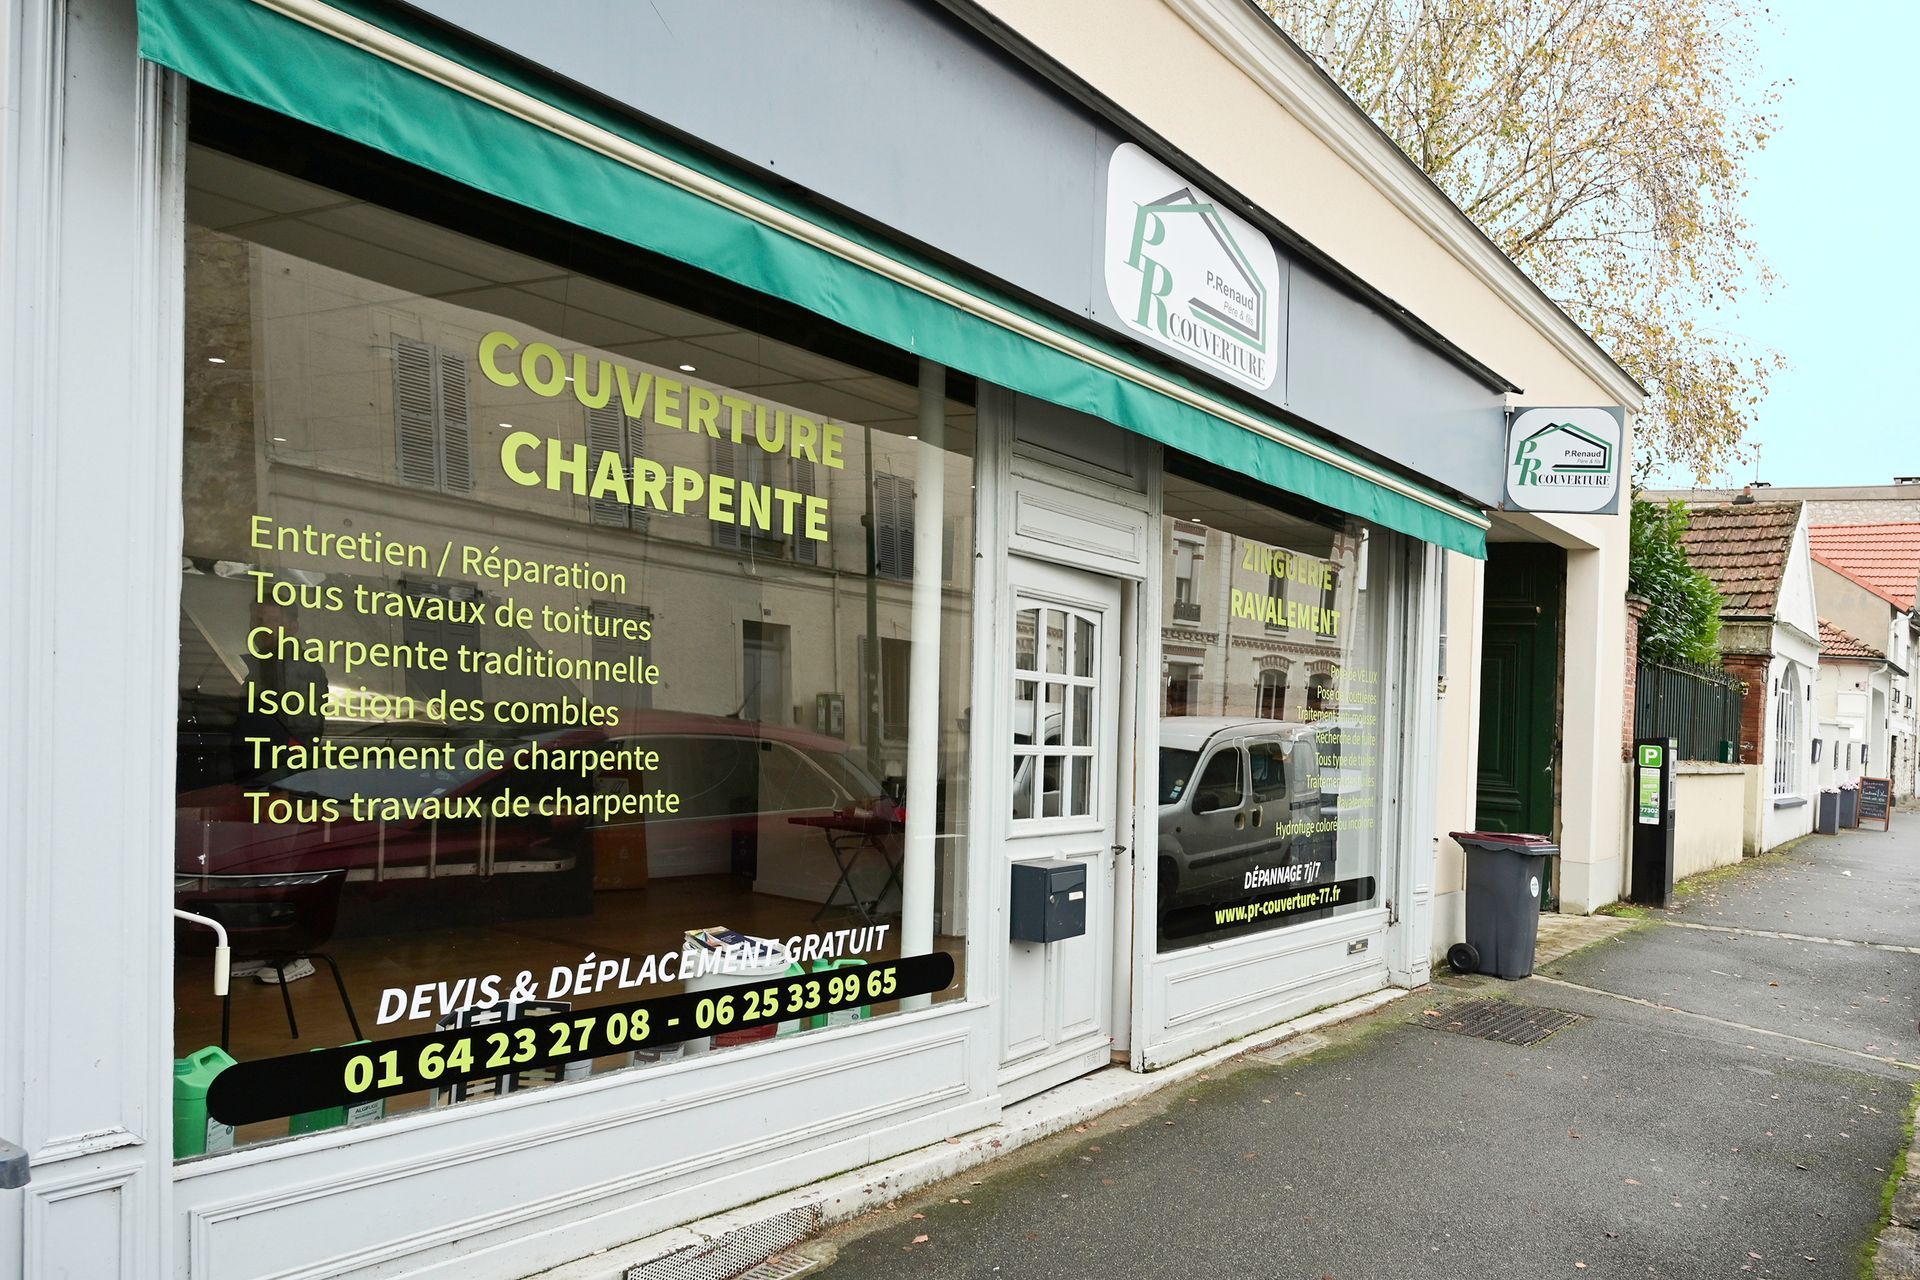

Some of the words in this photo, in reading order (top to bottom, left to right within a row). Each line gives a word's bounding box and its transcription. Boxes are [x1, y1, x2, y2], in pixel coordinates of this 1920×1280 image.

[1206, 270, 1253, 311] P.Renaud
[1169, 312, 1266, 381] COUVERTURE
[478, 331, 844, 470] COUVERTURE
[1564, 450, 1602, 458] P.Renaud
[500, 431, 829, 542] CHARPENTE
[1538, 474, 1610, 485] COUVERTURE
[250, 514, 428, 569] Entretien
[436, 541, 453, 577] /
[462, 545, 627, 594] Réparation
[1242, 542, 1333, 591] ZINGUERIE
[247, 570, 344, 612] Tous
[354, 584, 486, 624] travaux
[494, 597, 534, 630] de
[541, 604, 652, 641] toitures
[1231, 587, 1341, 636] RAVALEMENT
[246, 626, 449, 673] Charpente
[458, 644, 660, 685] traditionnelle
[247, 681, 415, 719] Isolation
[426, 688, 485, 722] des
[493, 695, 620, 727] combles
[1296, 705, 1337, 722] Traitement
[1317, 685, 1335, 700] Pose
[244, 736, 456, 770] Traitement
[464, 739, 505, 770] de
[512, 740, 660, 778] charpente
[1315, 730, 1351, 745] Recherche
[1352, 731, 1361, 745] de
[1315, 751, 1332, 766] Tous
[243, 792, 340, 824] Tous
[349, 792, 483, 821] travaux
[490, 787, 530, 818] de
[538, 787, 681, 822] charpente
[1275, 820, 1315, 839] Hydrofuge
[1315, 816, 1337, 834] coloré
[1243, 864, 1303, 890] DÉPANNAGE
[1303, 861, 1321, 884] 7j/7
[1214, 884, 1341, 925] www.pr-couverture-77.fr
[376, 974, 502, 1025] DEVIS
[509, 970, 539, 1005] &
[546, 938, 780, 1000] DÉPLACEMENT
[785, 924, 890, 963] GRATUIT
[343, 1049, 404, 1094] 01
[418, 1037, 474, 1080] 64
[485, 1027, 537, 1069] 23
[548, 1017, 597, 1057] 27
[606, 1008, 650, 1046] 08
[667, 1017, 680, 1027] -
[695, 994, 735, 1030] 06
[742, 987, 780, 1022] 25
[786, 980, 822, 1013] 33
[828, 974, 861, 1005] 99
[866, 966, 898, 998] 65
